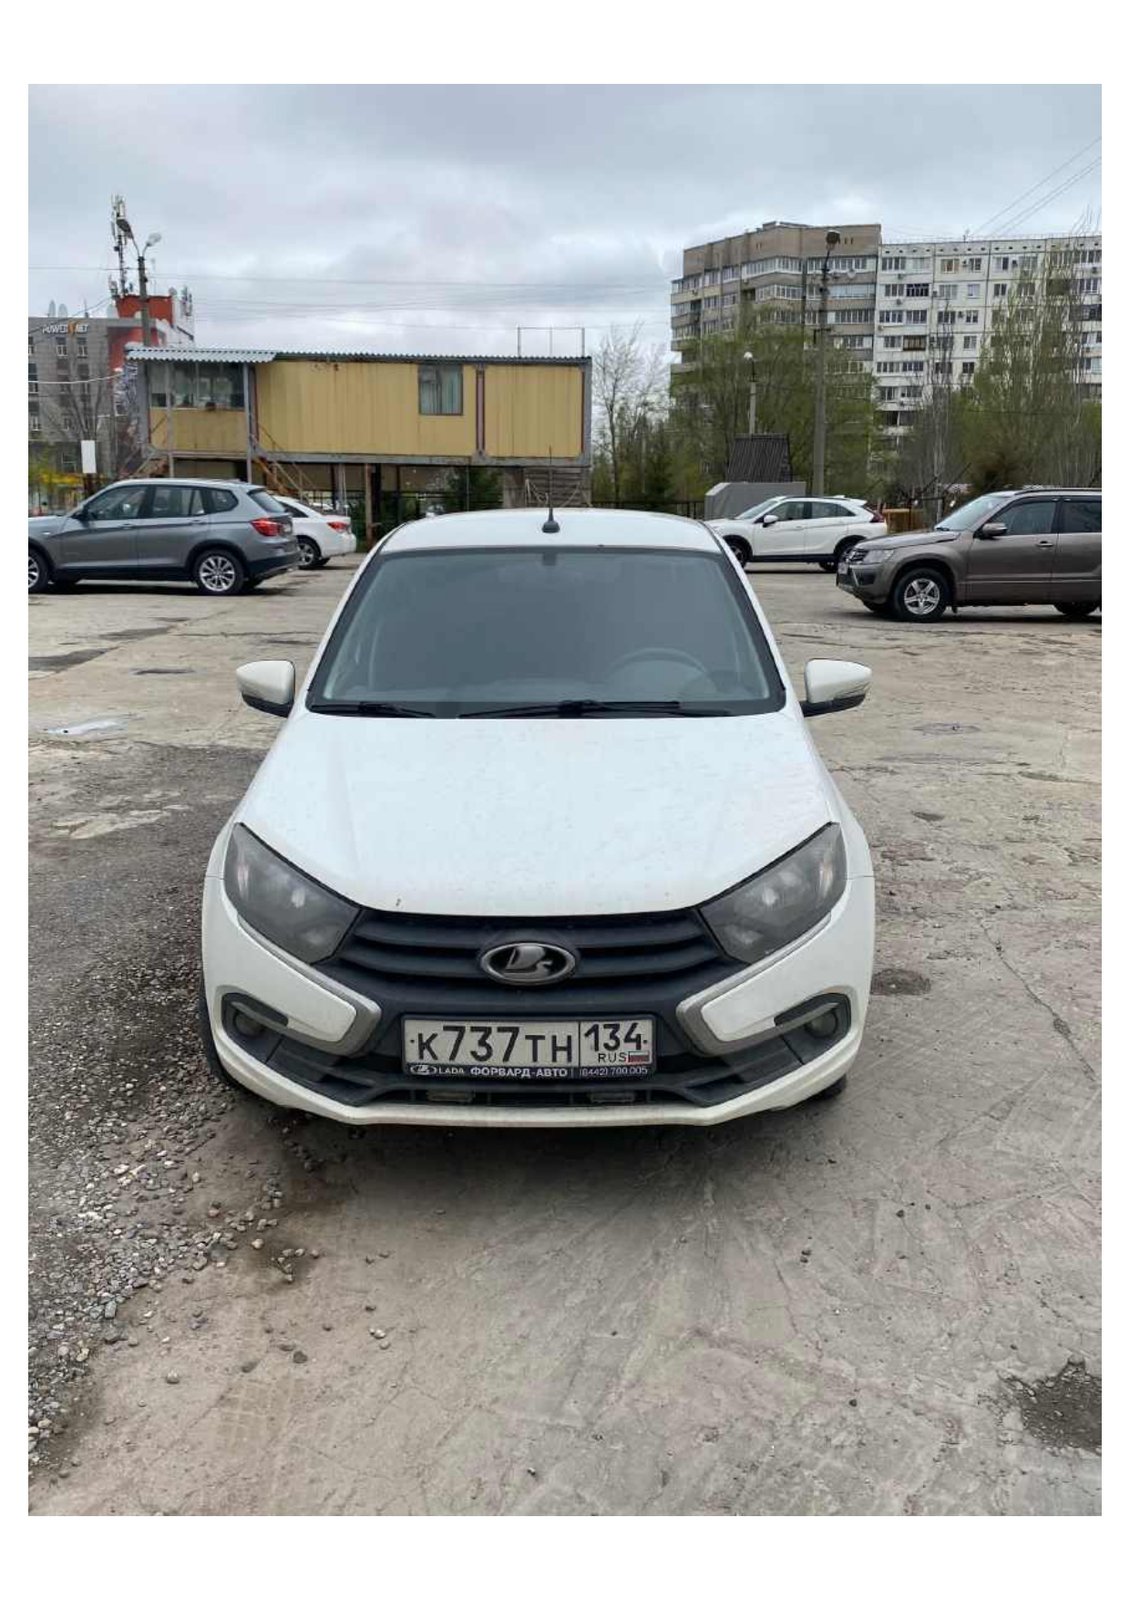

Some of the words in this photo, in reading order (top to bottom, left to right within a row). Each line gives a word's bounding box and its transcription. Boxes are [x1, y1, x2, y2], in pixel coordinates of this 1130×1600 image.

[584, 1022, 642, 1052] 134
[598, 1052, 627, 1063] RUS
[438, 1066, 465, 1075] LADA
[470, 1066, 569, 1078] ФОРВАРД-АВТО
